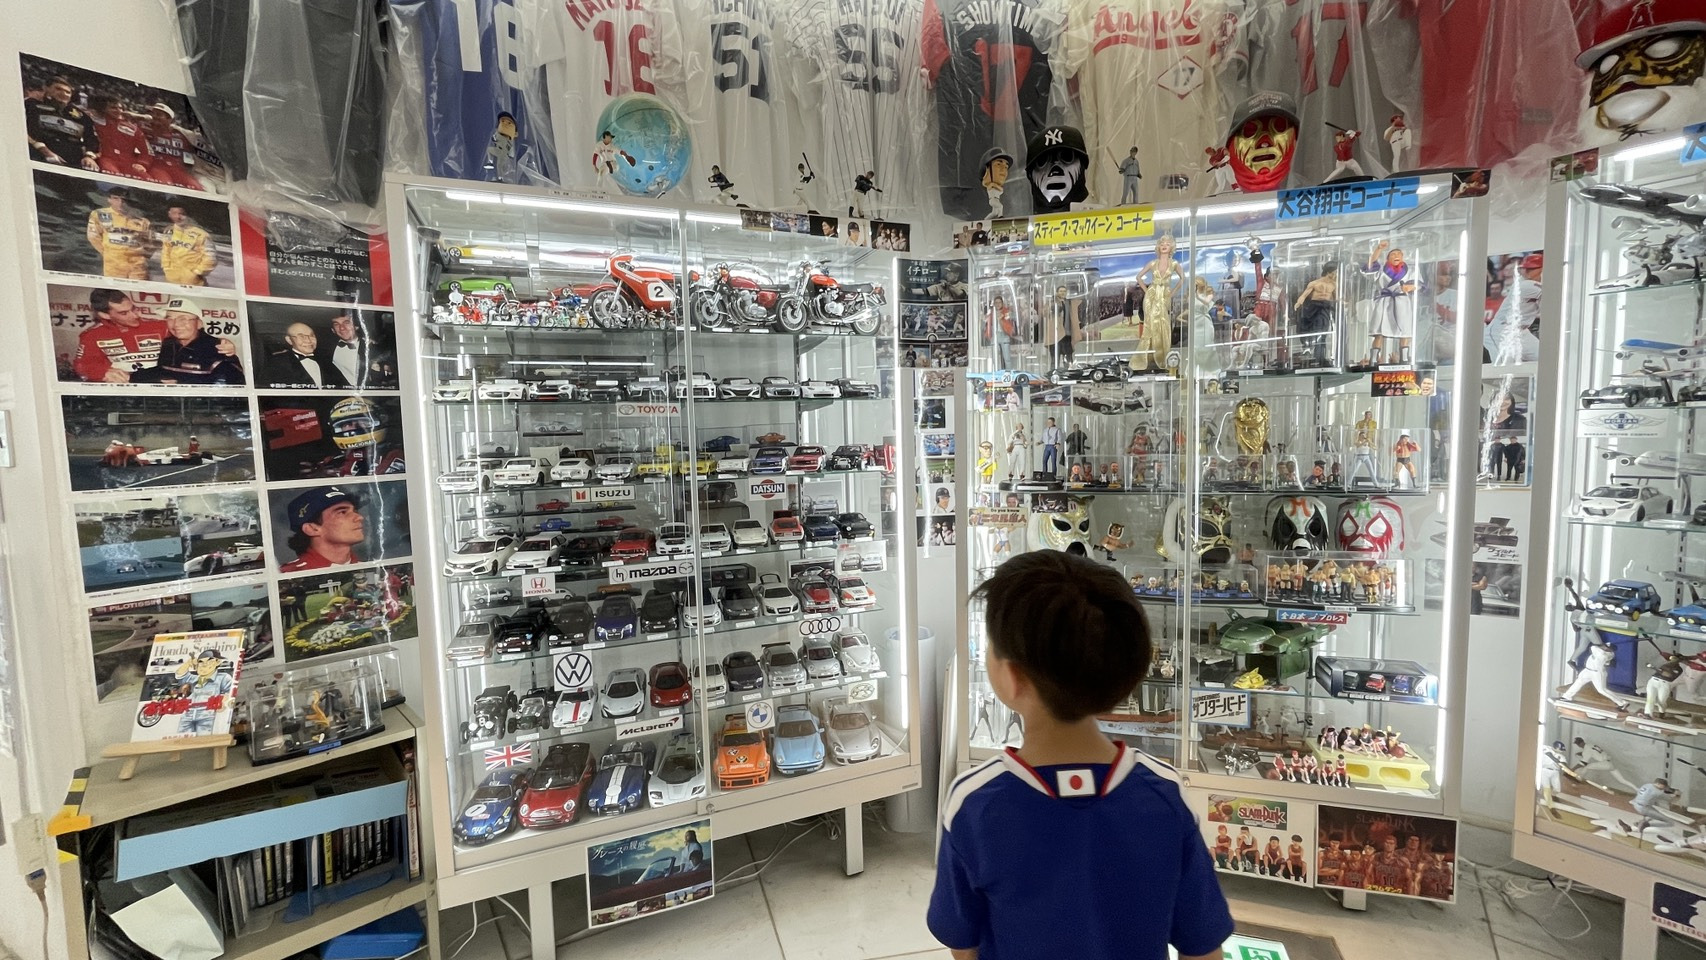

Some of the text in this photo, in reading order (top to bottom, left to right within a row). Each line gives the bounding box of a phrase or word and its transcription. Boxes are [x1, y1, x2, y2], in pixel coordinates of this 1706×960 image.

[956, 0, 1034, 33] SHOWTIM
[974, 37, 1033, 121] 17
[1044, 128, 1063, 146] NY
[1278, 181, 1417, 218] 大谷翔平コーナー
[1116, 212, 1152, 231] コーナー
[906, 265, 938, 276] イチロー
[653, 285, 665, 298] 2
[1003, 374, 1011, 383] 20
[595, 489, 631, 498] ISUZU
[752, 483, 783, 494] DATSUN
[629, 565, 677, 579] mazda
[1280, 611, 1345, 622] 全日本 プロレス
[154, 643, 189, 658] Honda
[1192, 694, 1247, 718] サンダーバード
[619, 721, 673, 737] McLaren
